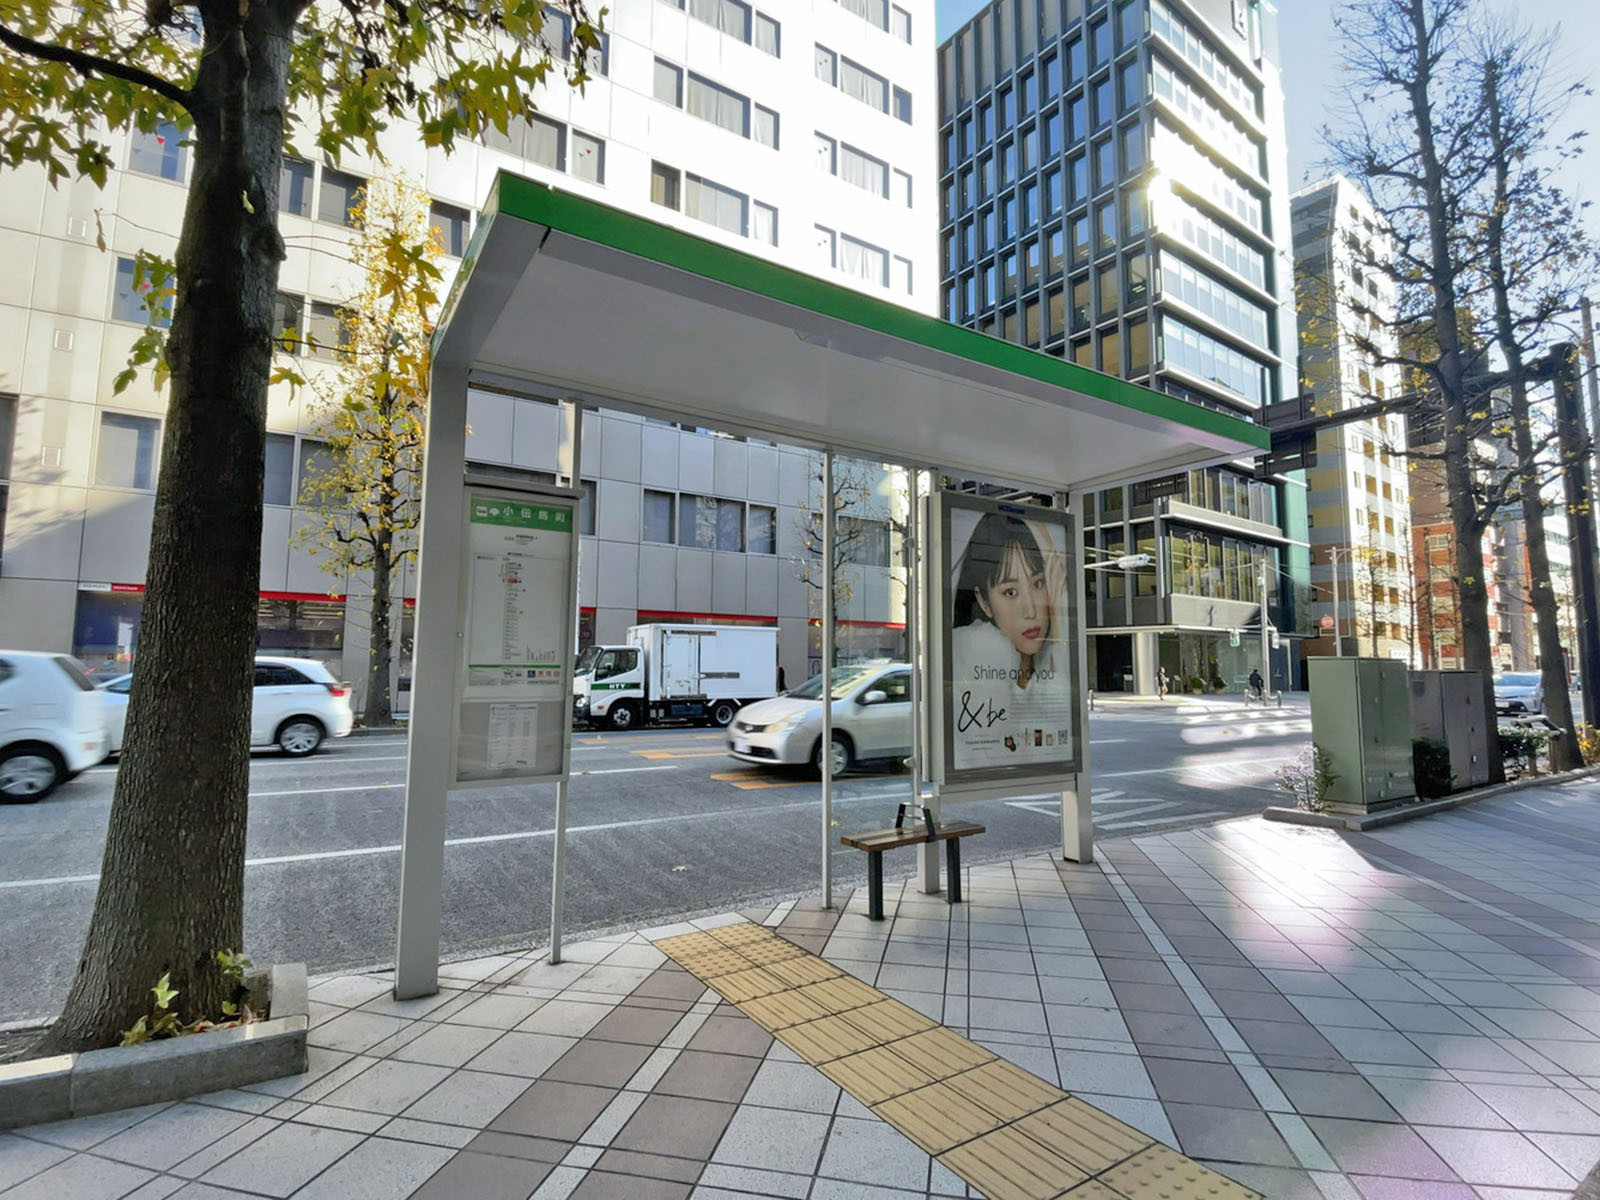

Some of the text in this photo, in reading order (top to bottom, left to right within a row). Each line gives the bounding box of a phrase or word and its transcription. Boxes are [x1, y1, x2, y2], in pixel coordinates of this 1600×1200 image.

[974, 665, 1055, 682] Shine and you
